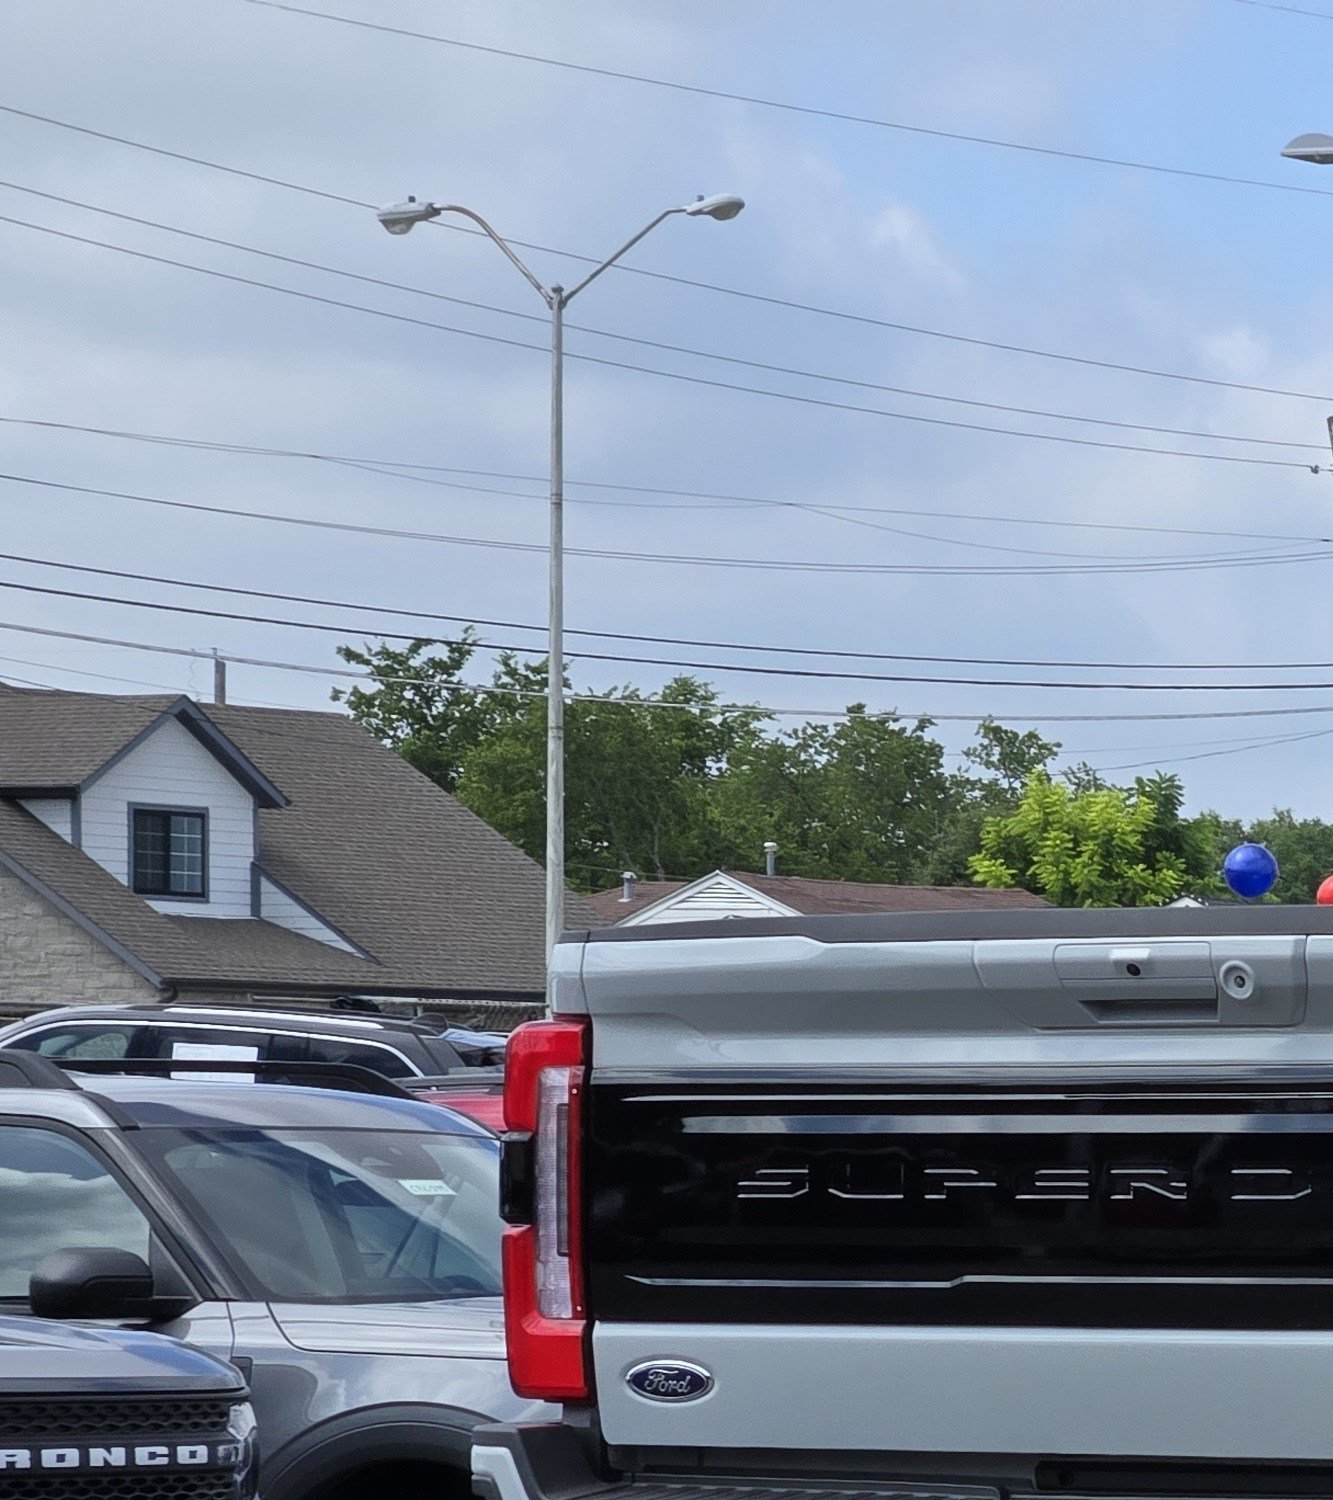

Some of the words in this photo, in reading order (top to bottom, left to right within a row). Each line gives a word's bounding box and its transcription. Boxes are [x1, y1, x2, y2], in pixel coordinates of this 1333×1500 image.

[736, 1168, 1188, 1200] SUPER
[643, 1368, 692, 1393] Ford
[0, 1445, 208, 1468] RONCO
